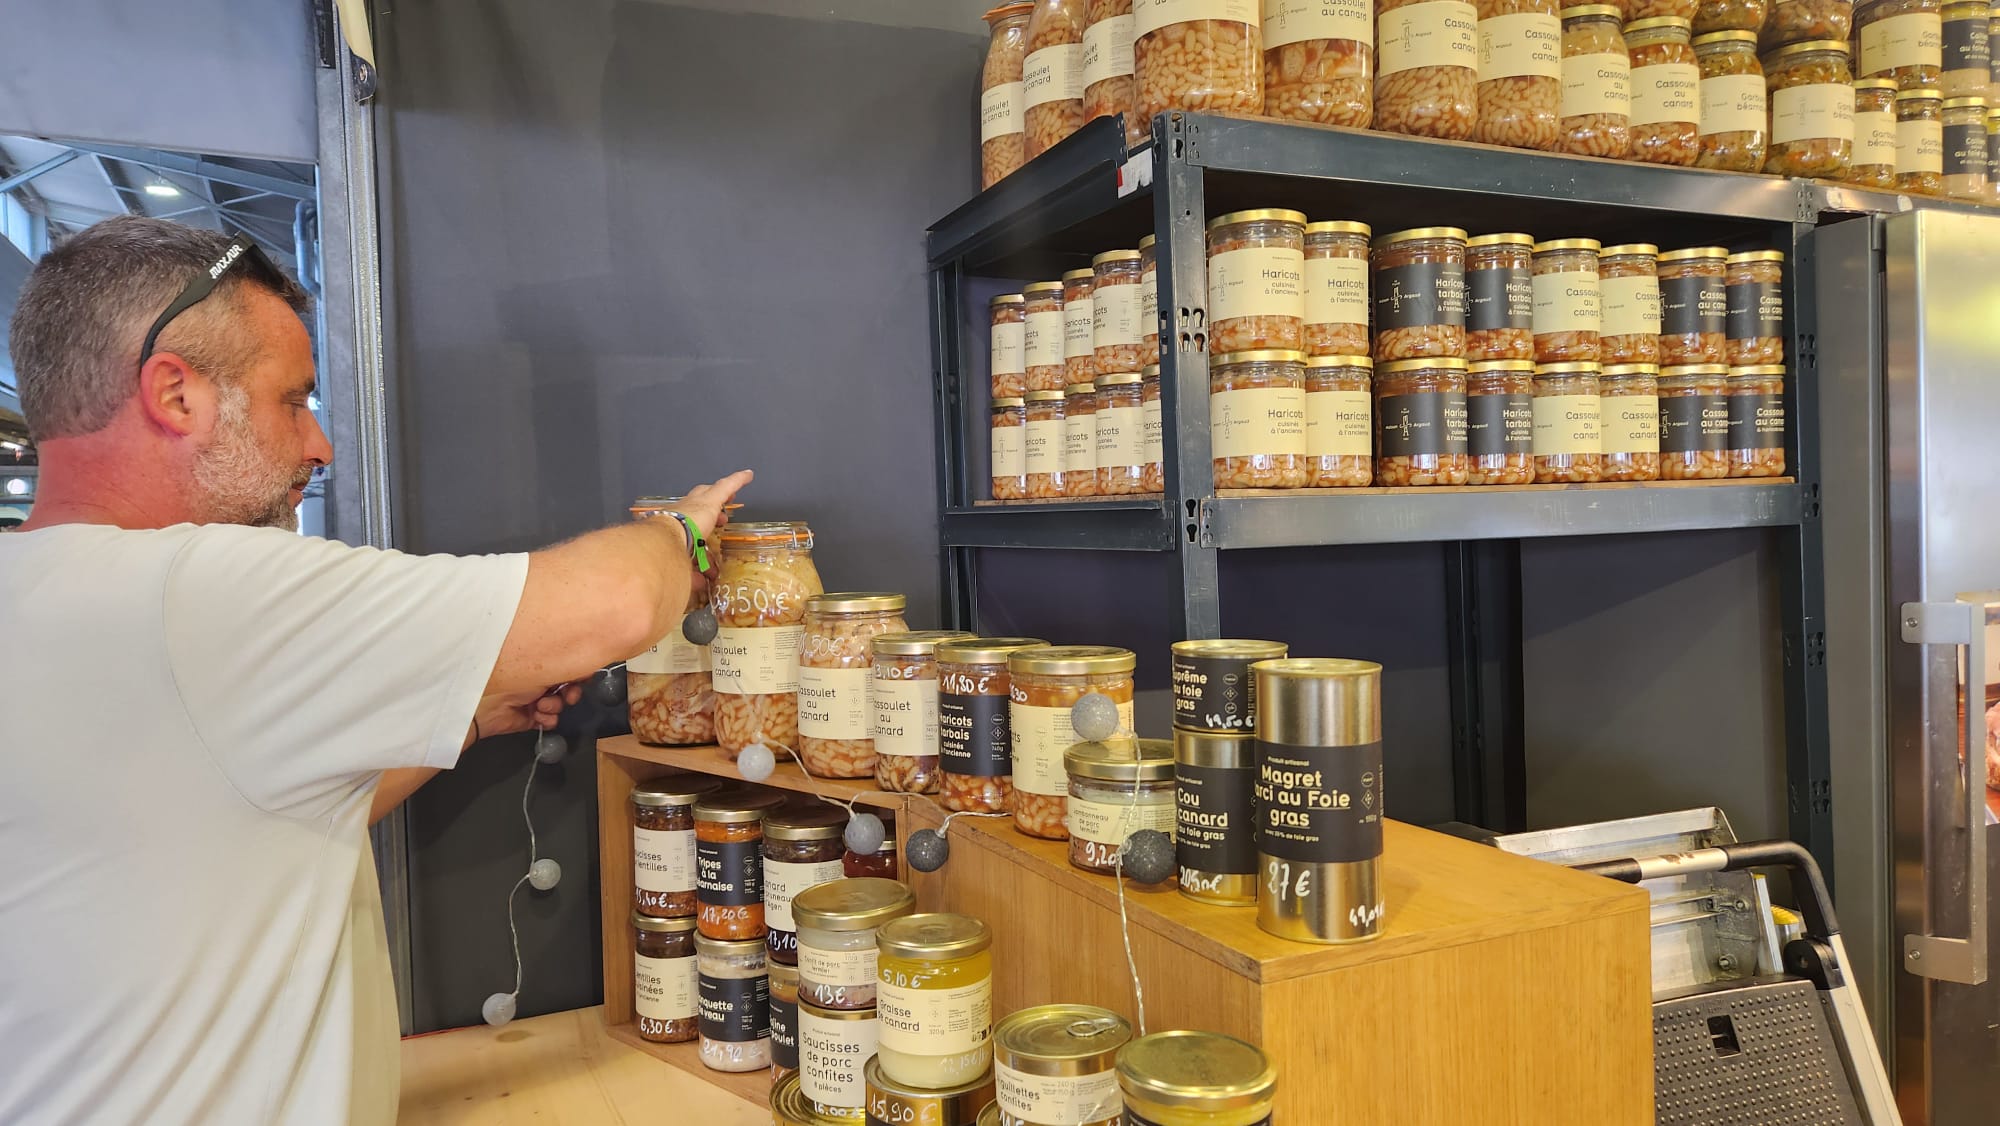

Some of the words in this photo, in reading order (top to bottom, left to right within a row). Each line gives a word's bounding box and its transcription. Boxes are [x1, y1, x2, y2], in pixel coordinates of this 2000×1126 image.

[1338, 9, 1367, 21] canard
[1444, 18, 1476, 32] Cassoule
[1461, 32, 1470, 41] au
[1525, 29, 1560, 43] Cassoule
[1542, 42, 1552, 51] au
[1597, 69, 1629, 81] Cassoule
[1613, 81, 1623, 90] au
[1674, 89, 1686, 98] au
[1262, 269, 1300, 280] Haricots
[1327, 279, 1364, 289] Haricots
[1435, 278, 1464, 289] Haricots
[1584, 299, 1593, 307] au
[1698, 301, 1712, 309] au
[1268, 409, 1303, 418] Haricots
[1336, 412, 1369, 421] Haricots
[1503, 409, 1532, 419] Haricots
[1566, 411, 1600, 420] Cassoule
[1622, 411, 1658, 420] Cassoule
[1506, 420, 1531, 429] tarbais
[1701, 420, 1713, 428] au
[1755, 418, 1767, 426] au
[720, 658, 730, 666] au
[715, 667, 741, 678] canard
[977, 677, 990, 693] €
[1182, 684, 1202, 697] foie
[798, 687, 836, 698] assoulet
[807, 701, 817, 709] au
[874, 700, 912, 711] assoulet
[1176, 699, 1195, 710] gras
[801, 711, 829, 722] canard
[880, 714, 891, 723] au
[875, 726, 904, 736] canard
[1262, 764, 1322, 789] Magret
[1178, 787, 1199, 806] Cou
[1255, 784, 1274, 801] arci
[1278, 790, 1301, 806] au
[1308, 790, 1350, 807] Foie
[1178, 808, 1228, 827] canard
[1270, 809, 1310, 826] gras
[1086, 820, 1100, 828] porc
[1186, 827, 1201, 837] foie
[1203, 831, 1225, 840] gras
[698, 856, 722, 870] Tripes
[702, 870, 707, 878] à
[707, 870, 717, 880] la
[1295, 870, 1311, 897] €
[883, 969, 907, 987] 5,10
[880, 1000, 911, 1018] Graisse
[704, 1010, 725, 1021] veau
[640, 1017, 662, 1034] 6,30
[664, 1020, 673, 1033] €
[884, 1015, 920, 1032] canard
[802, 1032, 860, 1053] Saucisses
[807, 1050, 818, 1063] de
[822, 1056, 852, 1068] porc
[807, 1065, 853, 1083] confites
[818, 1083, 842, 1093] pièces
[1000, 1079, 1040, 1100] guillettes
[1000, 1091, 1032, 1112] confites
[871, 1093, 914, 1123] 15,90
